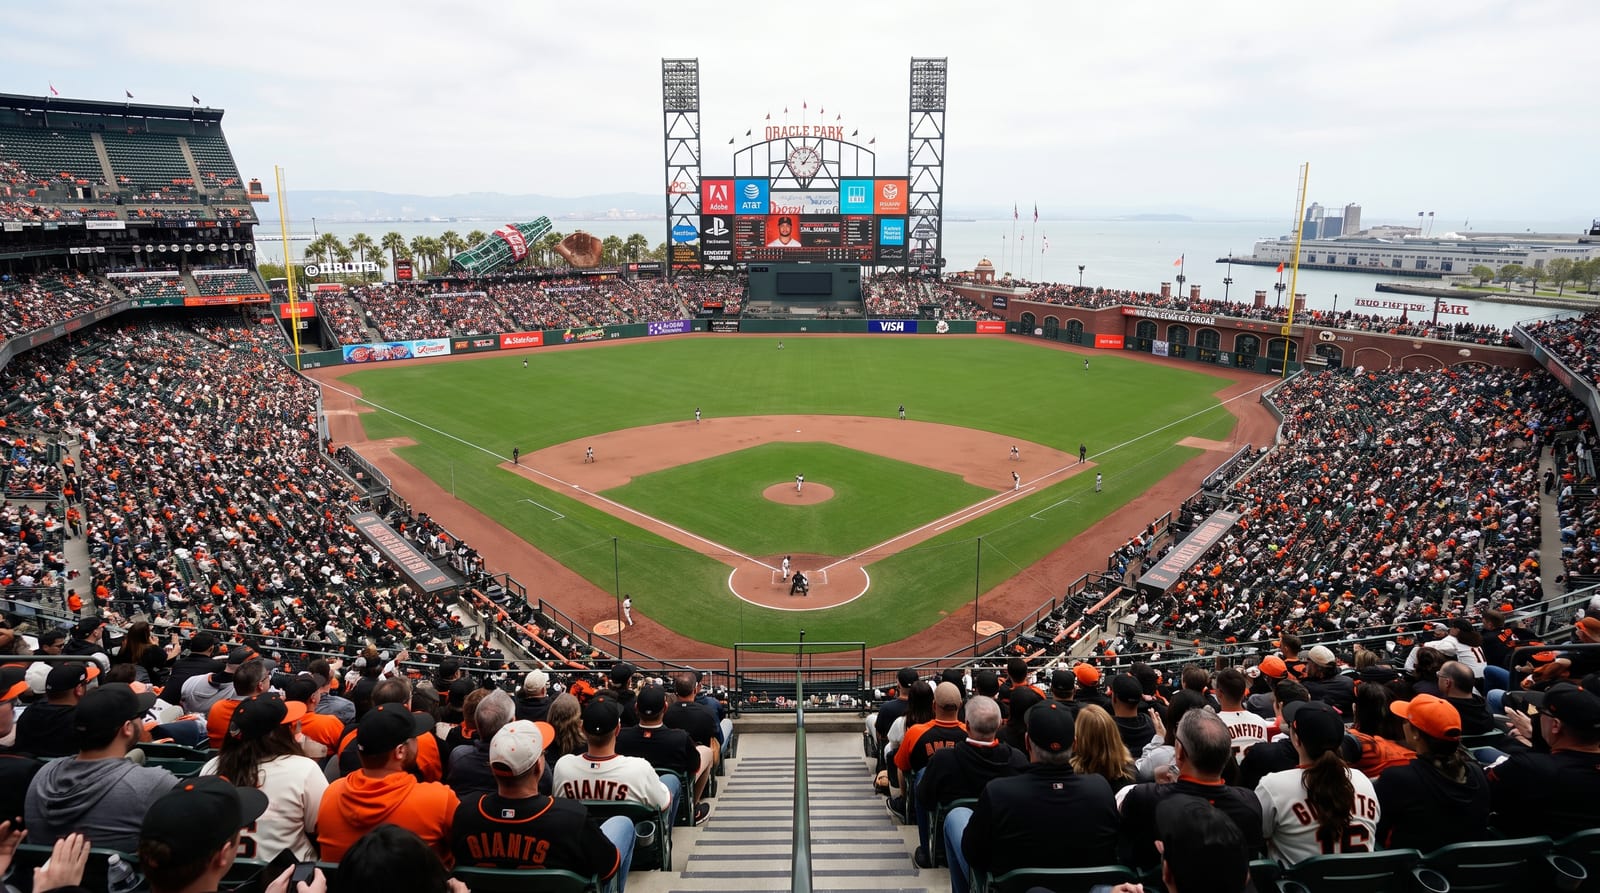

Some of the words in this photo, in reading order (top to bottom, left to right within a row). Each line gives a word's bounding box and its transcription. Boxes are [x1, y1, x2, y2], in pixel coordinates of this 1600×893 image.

[765, 125, 810, 141] ORACLE
[813, 125, 844, 141] PARK
[563, 779, 629, 801] GIANTS
[466, 831, 551, 864] GIANTS
